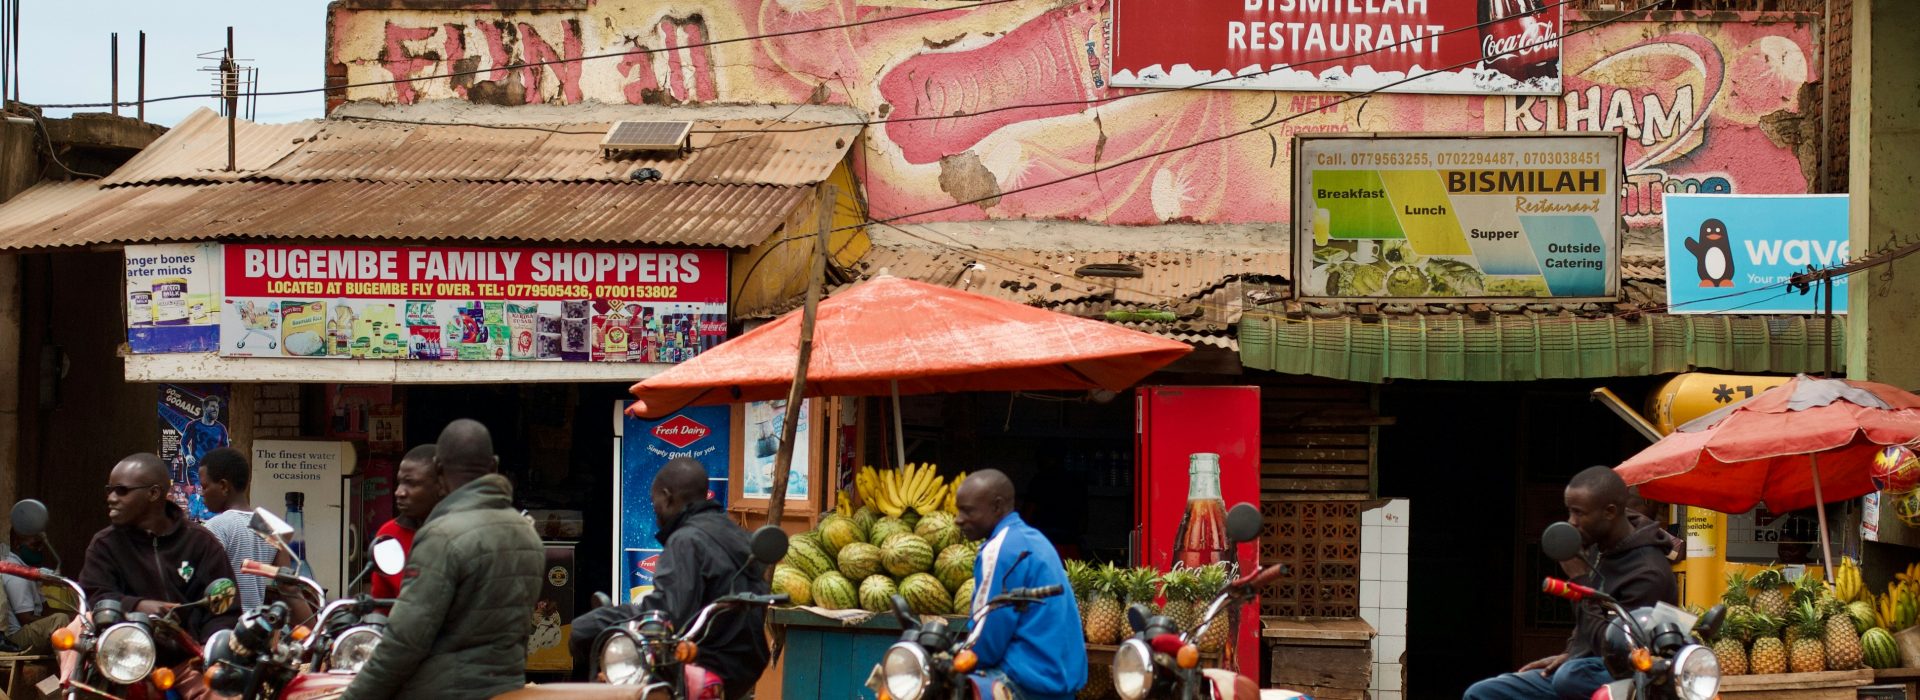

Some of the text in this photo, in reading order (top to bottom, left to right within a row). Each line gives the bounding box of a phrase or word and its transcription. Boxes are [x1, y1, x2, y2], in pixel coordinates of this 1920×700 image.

[1228, 21, 1444, 53] RESTAURANT
[1483, 19, 1559, 64] Coca-Cola
[379, 19, 584, 105] FUN
[1289, 95, 1343, 114] NEW
[1317, 152, 1600, 168] Call. 0779563255, 0702294487, 0703038451
[1448, 171, 1600, 193] BISMILAH
[1317, 189, 1385, 199] Breakfast
[1405, 205, 1446, 216] Lunch
[1515, 196, 1600, 214] Restaurant
[1471, 229, 1519, 241] Supper
[1548, 243, 1600, 254] Outside
[161, 254, 195, 264] bones
[1545, 258, 1603, 270] Catering
[157, 265, 192, 275] minds
[245, 249, 700, 283] BUGEMBE FAMILY SHOPPERS
[1747, 273, 1773, 284] Your
[267, 281, 677, 299] LOCATED AT BUGEMBE FLY OVER. TEL: 0779505436, 0700153802
[655, 425, 706, 437] Fresh Dairy
[256, 450, 336, 460] The finest water
[646, 443, 669, 458] Simply
[693, 450, 703, 458] for
[704, 445, 716, 455] you
[264, 460, 327, 471] for the finest
[273, 472, 321, 480] occasions
